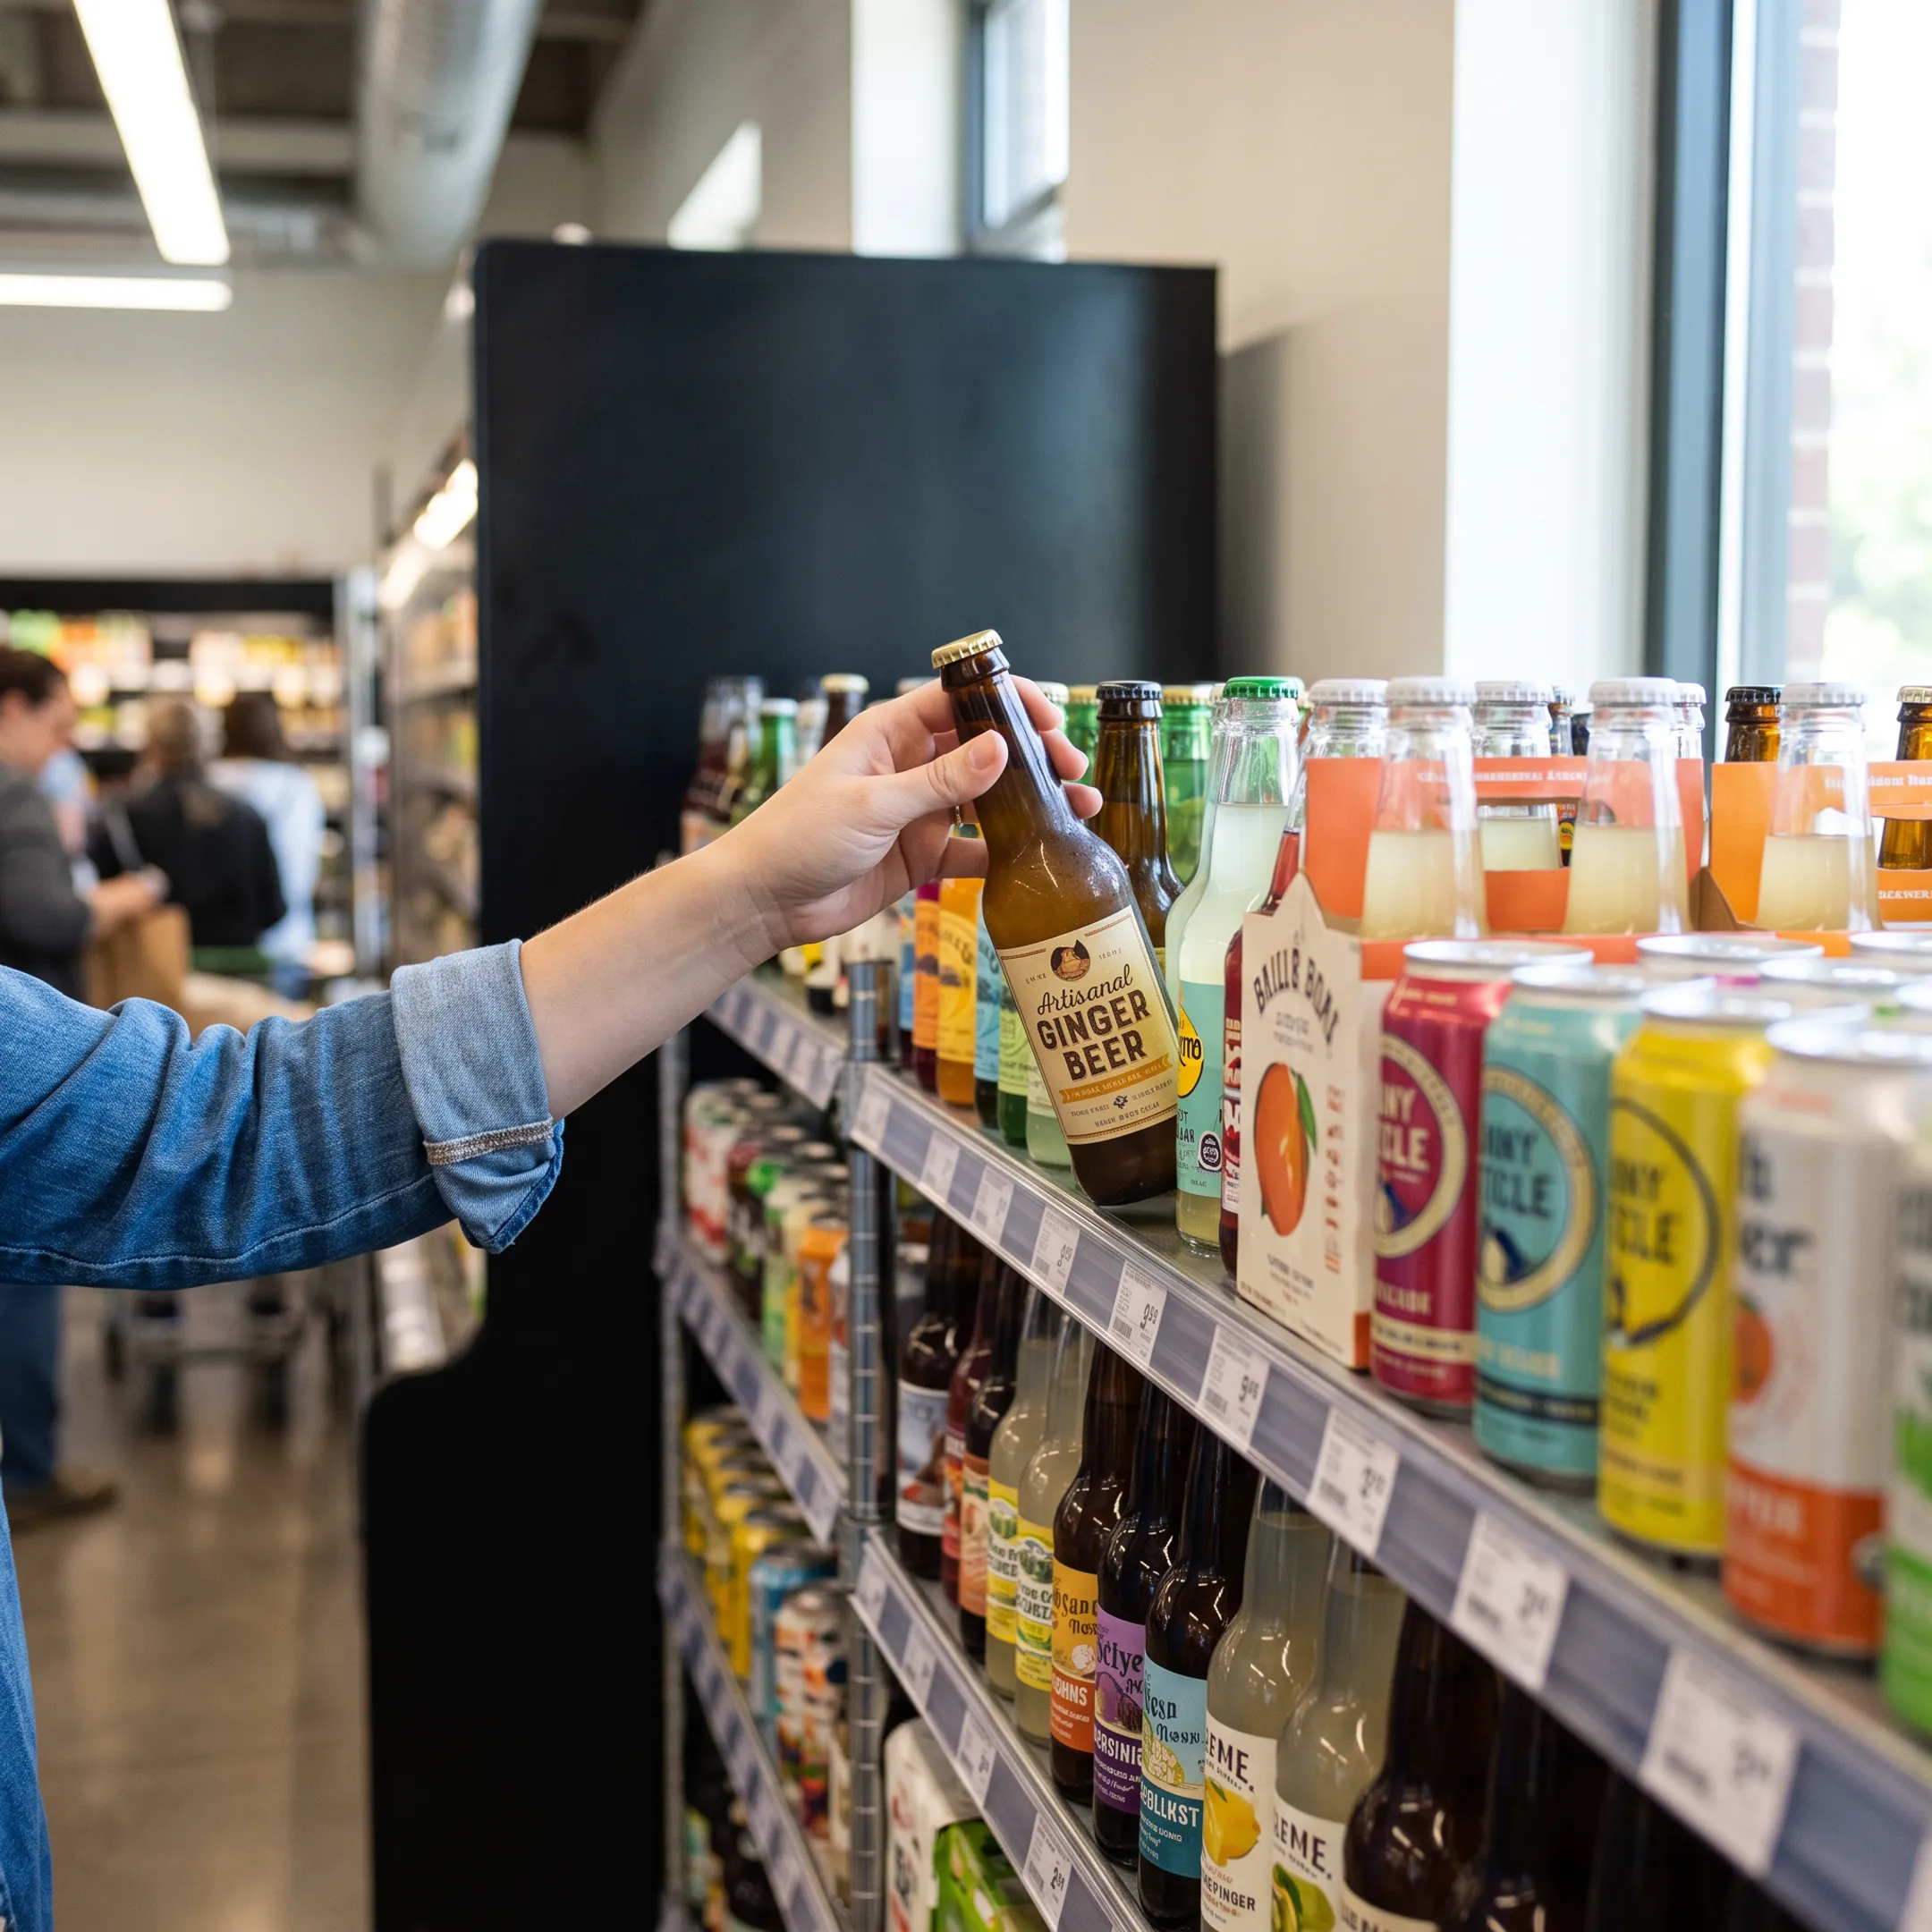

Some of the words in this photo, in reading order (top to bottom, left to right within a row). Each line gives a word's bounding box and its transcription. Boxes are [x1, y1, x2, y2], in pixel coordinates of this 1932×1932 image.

[1037, 963, 1133, 1015] Artisanal
[1037, 988, 1151, 1051] GINGER
[1063, 1030, 1149, 1081] BEER
